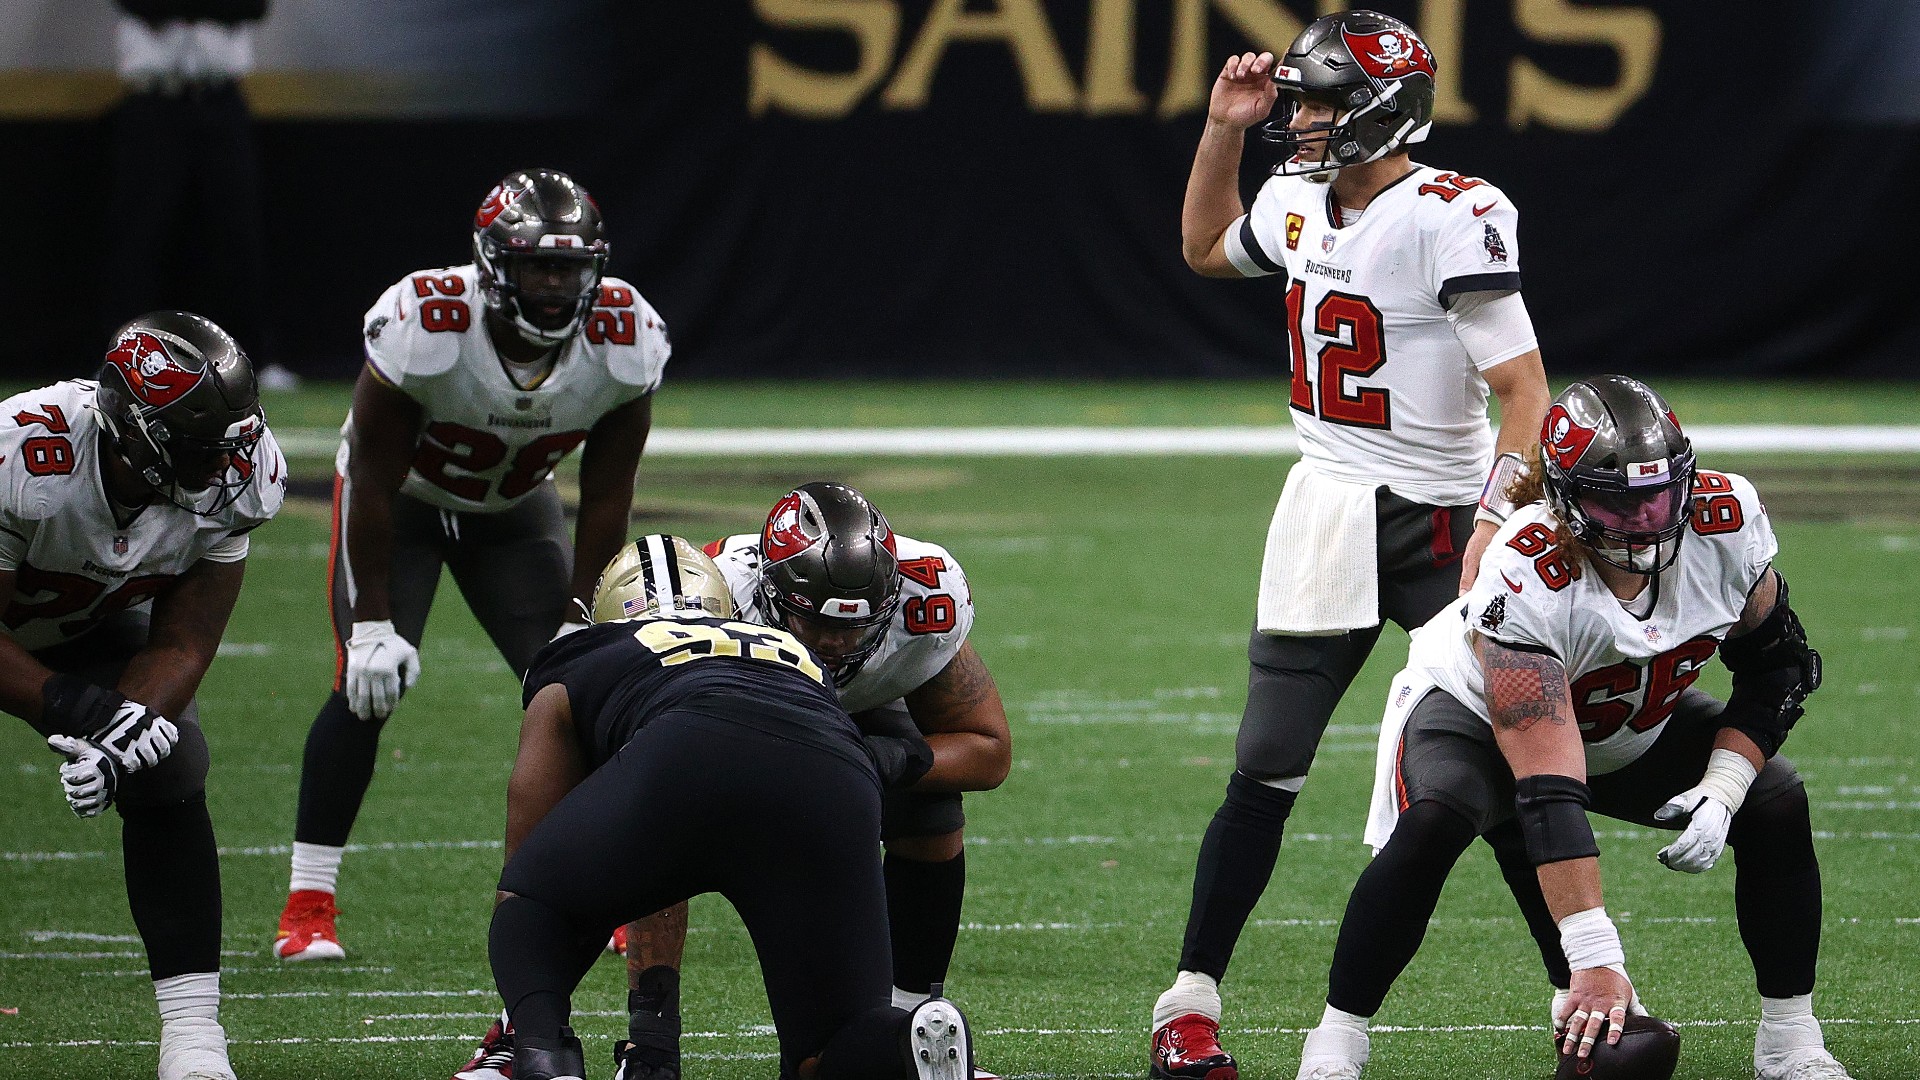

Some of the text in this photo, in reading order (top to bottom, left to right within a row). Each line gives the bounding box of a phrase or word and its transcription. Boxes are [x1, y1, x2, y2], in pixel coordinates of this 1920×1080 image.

[1418, 173, 1488, 203] 12
[412, 275, 471, 333] 28
[1305, 259, 1352, 284] BUCCANEERS
[586, 286, 635, 346] 28
[1285, 278, 1391, 431] 12
[11, 404, 76, 477] 78
[411, 420, 589, 502] 28
[1689, 472, 1745, 537] 66
[1505, 522, 1582, 593] 66
[673, 594, 685, 610] 3
[898, 556, 957, 636] 64
[633, 620, 827, 688] 93
[1569, 635, 1722, 743] 66
